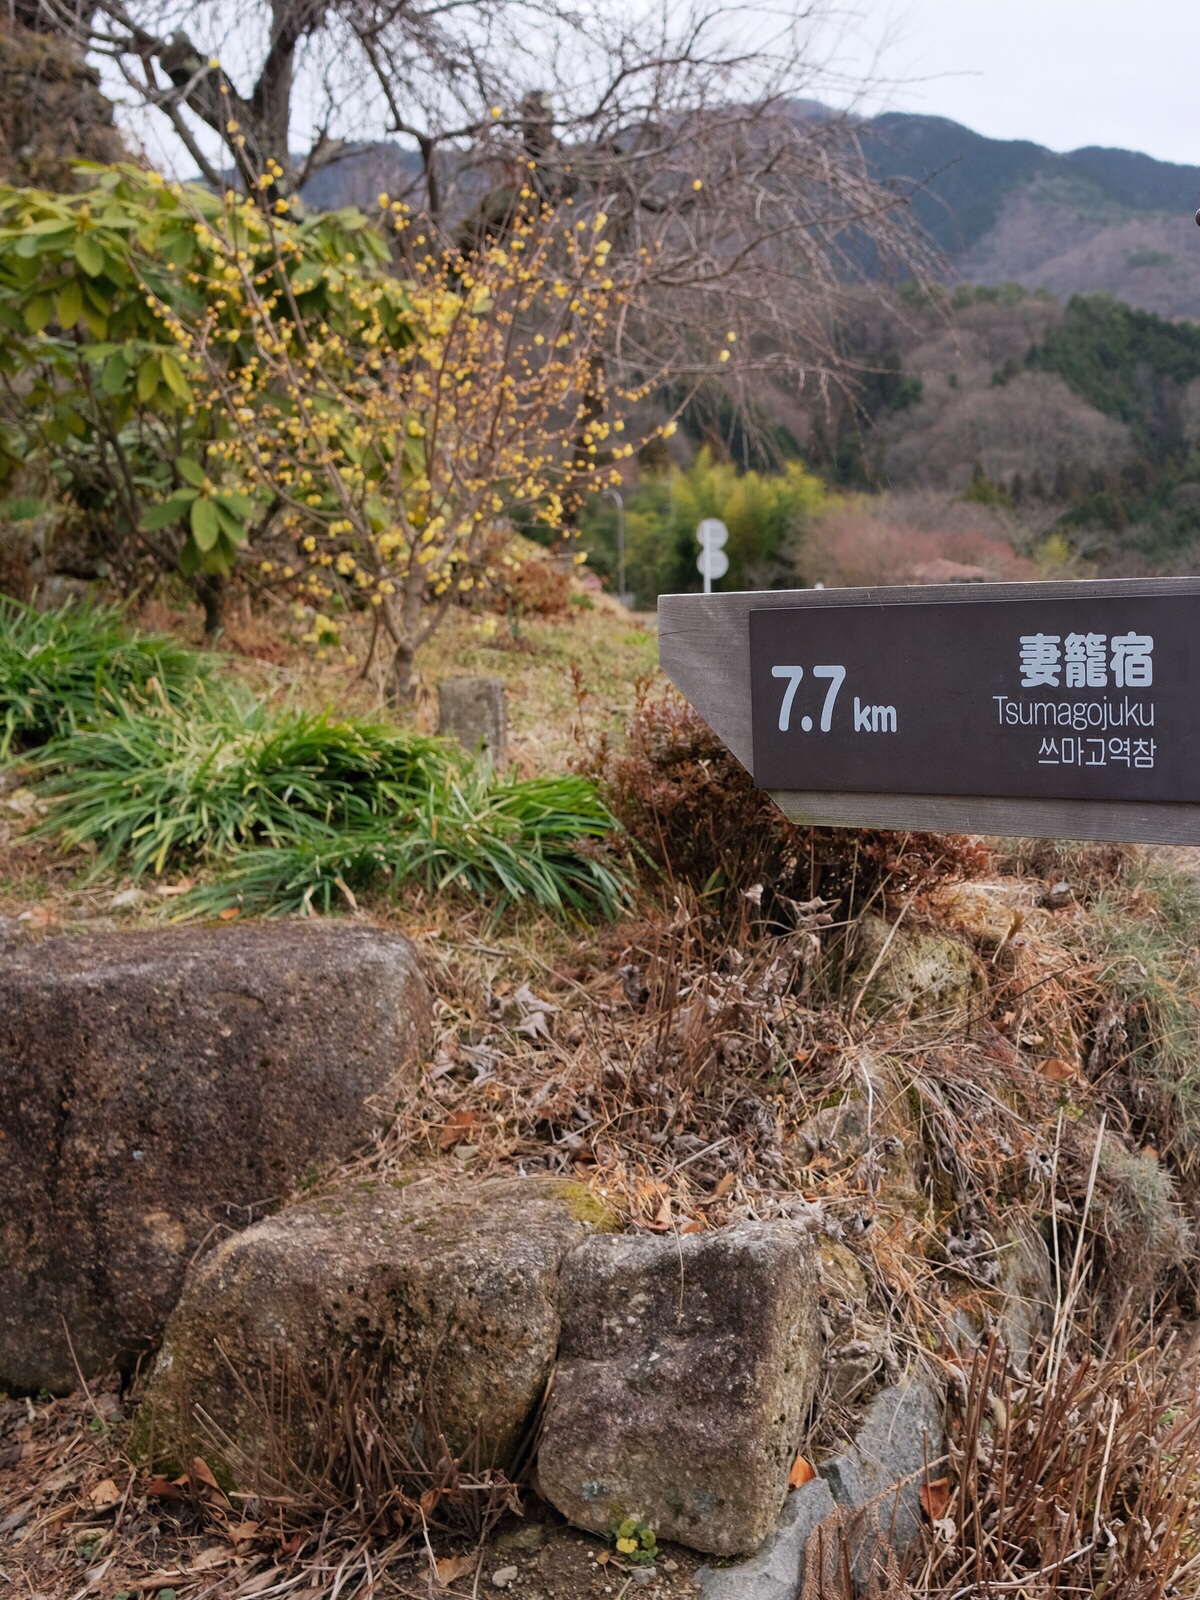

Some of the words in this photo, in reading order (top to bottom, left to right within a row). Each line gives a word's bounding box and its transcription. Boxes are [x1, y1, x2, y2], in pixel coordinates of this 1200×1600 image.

[1018, 630, 1154, 688] 妻籠宿
[771, 665, 847, 733] 7.7
[853, 696, 898, 733] km
[992, 695, 1155, 731] Tsumagojuku
[1038, 736, 1157, 769] 쓰마고역참
